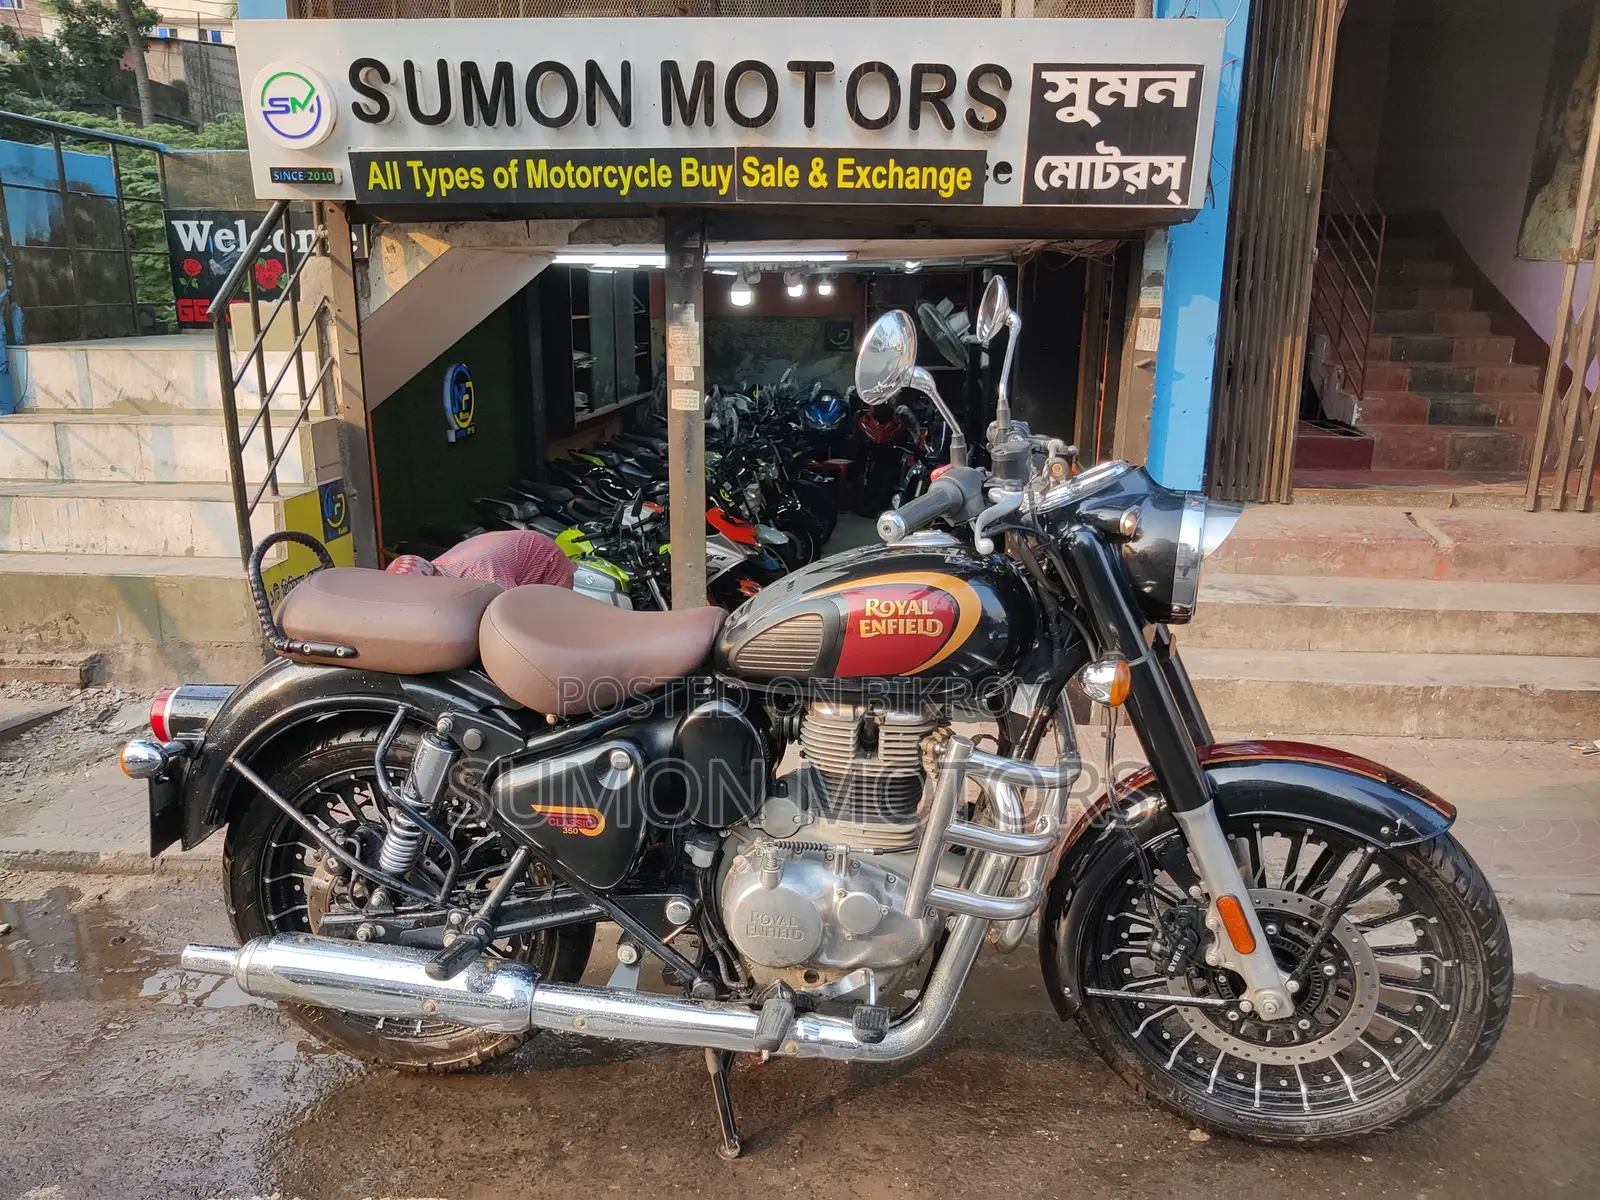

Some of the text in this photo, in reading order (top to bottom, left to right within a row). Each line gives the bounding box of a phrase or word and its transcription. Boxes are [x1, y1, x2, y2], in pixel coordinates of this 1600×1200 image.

[348, 57, 1013, 132] SUMON MOTORS
[1040, 70, 1197, 128] সুমন
[273, 170, 334, 181] SINCE 2010
[367, 156, 972, 199] All Types of Motorcycle Buy Sale & Exchange
[1034, 140, 1187, 205] মোটরস্
[864, 598, 934, 618] ROYAL
[859, 618, 944, 638] ENFIELD
[547, 817, 596, 829] CLASSIC
[562, 827, 579, 835] 350
[752, 911, 798, 928] ROYAL
[746, 924, 804, 942] ENFIELD
